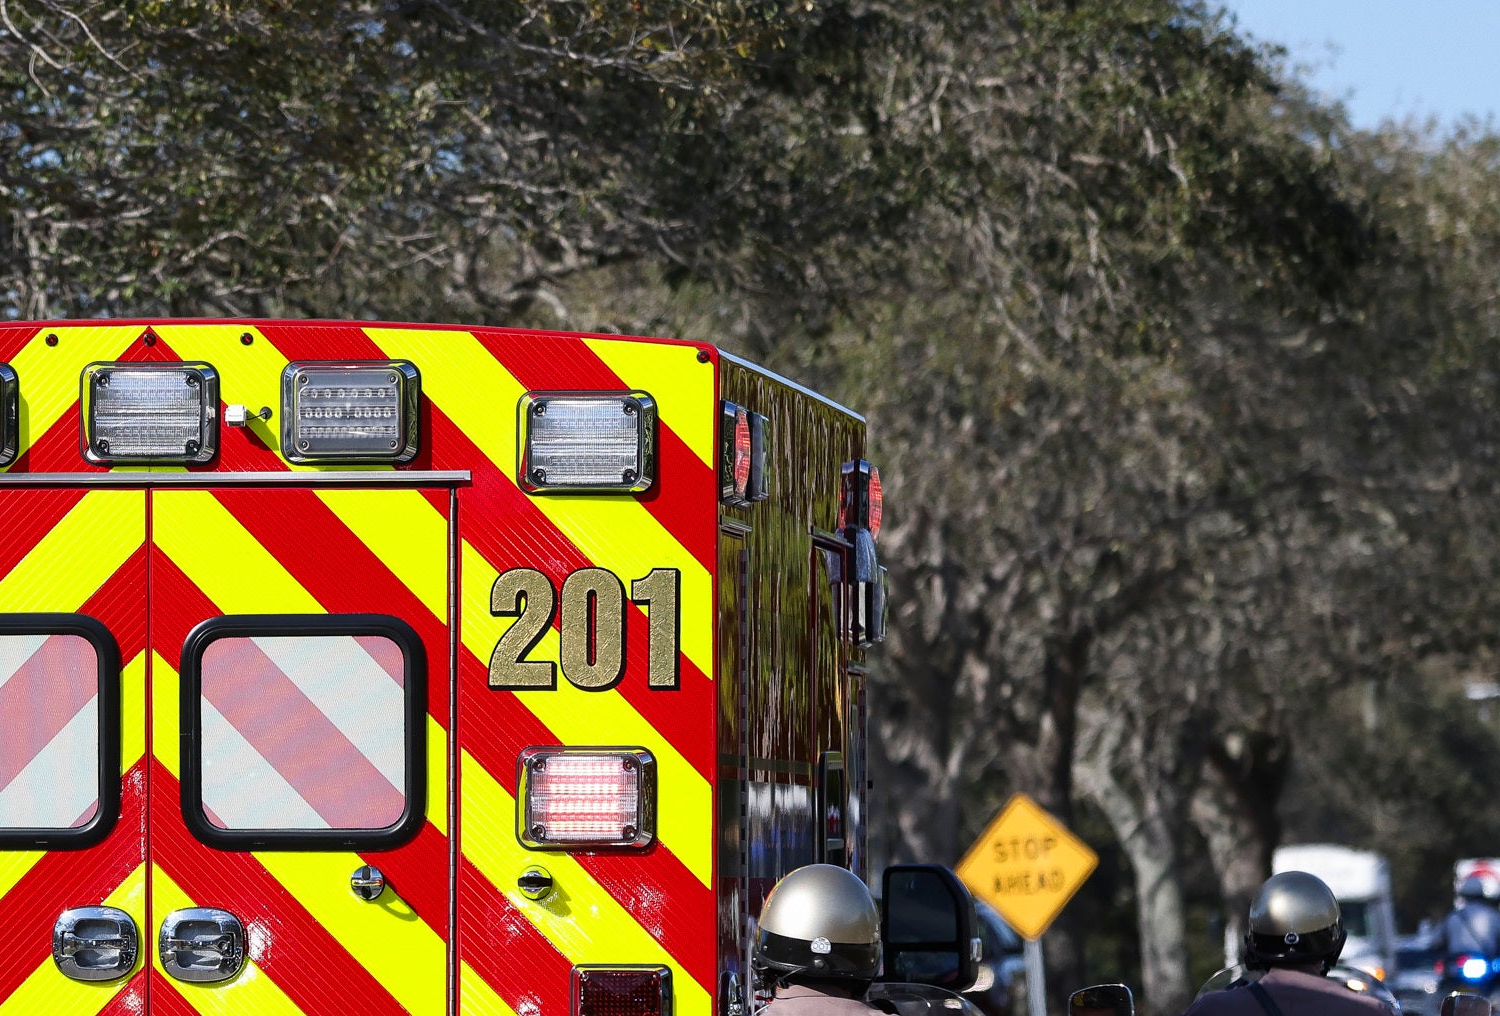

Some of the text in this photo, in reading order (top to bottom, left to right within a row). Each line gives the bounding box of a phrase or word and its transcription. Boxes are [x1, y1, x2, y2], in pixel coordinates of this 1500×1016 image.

[487, 566, 681, 691] 201
[994, 836, 1058, 863] STOP
[993, 870, 1066, 895] AHEAD
